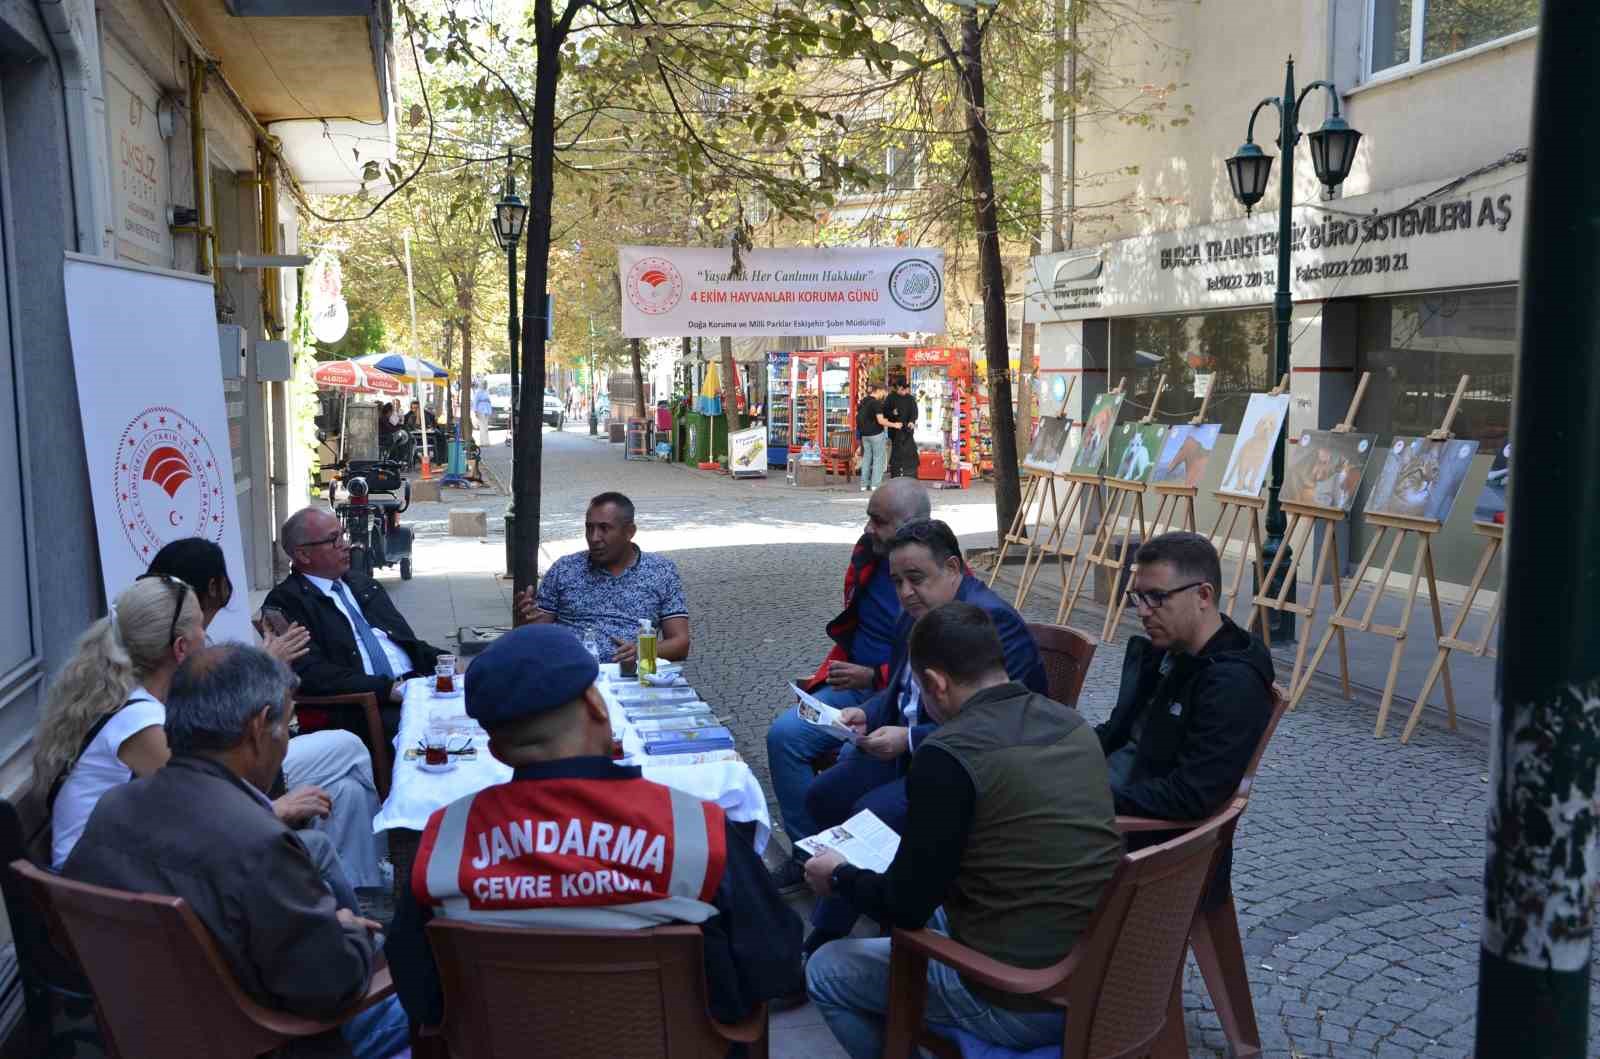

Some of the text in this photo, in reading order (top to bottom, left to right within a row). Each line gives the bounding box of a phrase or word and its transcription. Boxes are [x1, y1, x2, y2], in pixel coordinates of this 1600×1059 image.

[1160, 192, 1513, 270] BURSA TRANSTEKİK BÜRO SİSTEMLERİ AŞ
[751, 269, 772, 281] Her
[1350, 255, 1373, 275] 220
[1374, 254, 1391, 273] 30
[1392, 252, 1409, 270] 21
[690, 287, 879, 303] 4 EKİM HAYVANLARI KORUMA GÜNÜ
[688, 319, 707, 330] Doğa
[709, 320, 737, 329] Koruma
[767, 320, 791, 328] Parklar
[471, 817, 666, 875] JANDARMA
[472, 874, 553, 902] ÇEVRE
